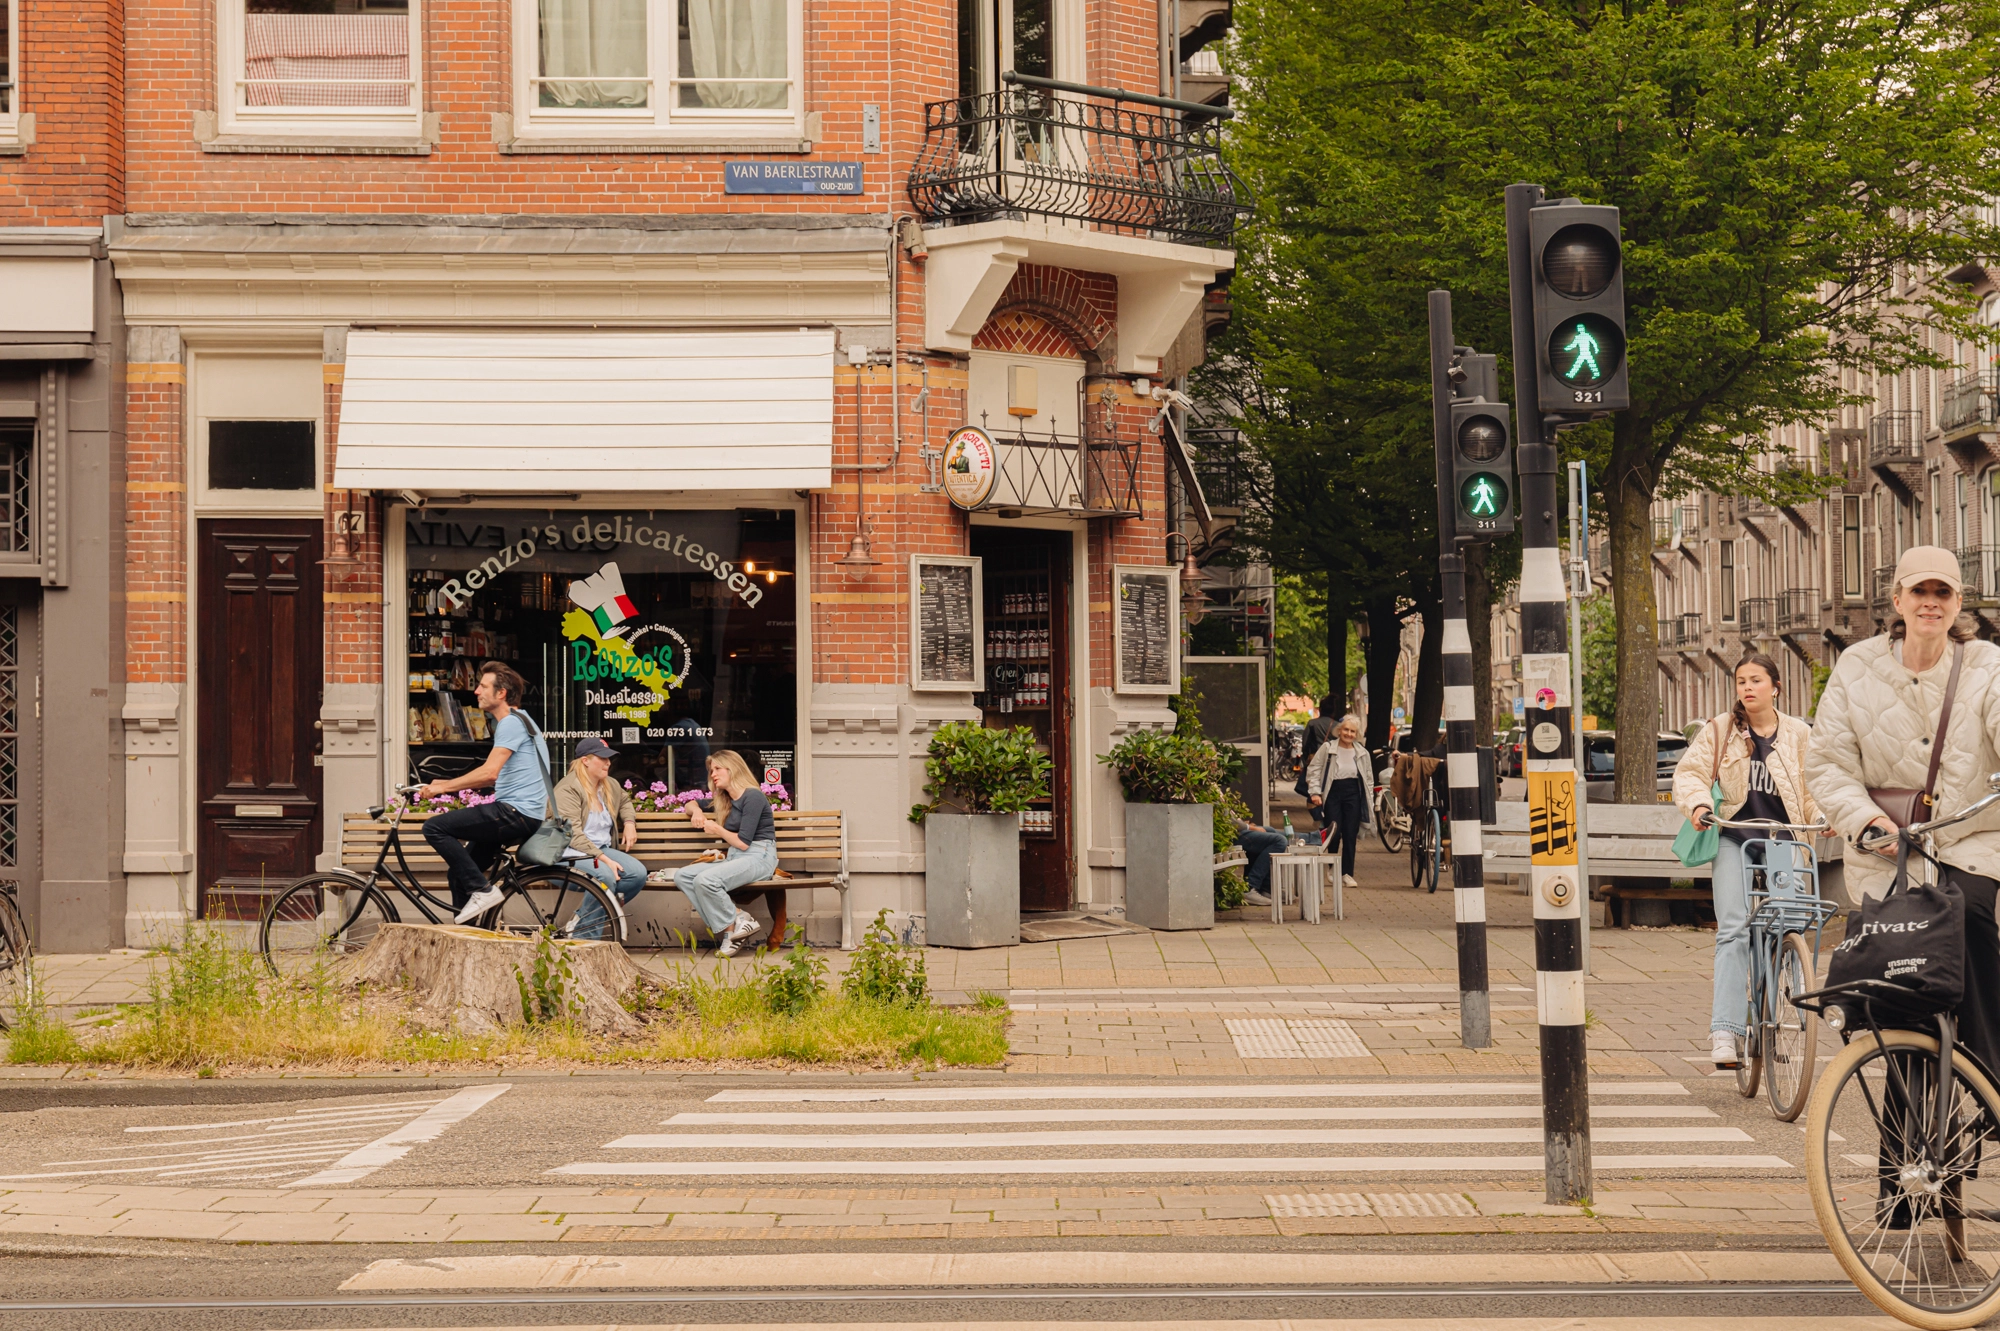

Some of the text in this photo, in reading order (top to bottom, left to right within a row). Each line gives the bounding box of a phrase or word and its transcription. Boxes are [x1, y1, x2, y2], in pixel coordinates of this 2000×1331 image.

[732, 165, 856, 179] VAN BAERLESTRAAT
[820, 182, 854, 191] OUD-ZUID
[1575, 391, 1601, 403] 321
[963, 432, 991, 470] MORETTI
[1478, 520, 1496, 529] 311
[440, 515, 763, 609] Renzo's delicatessen
[654, 623, 685, 645] Cateringen
[668, 647, 693, 690] Boodschappen
[585, 686, 665, 706] Delicatessen
[603, 710, 647, 719] Sinds 1986
[647, 727, 713, 738] 020 673 1 673
[1887, 956, 1927, 969] insinger
